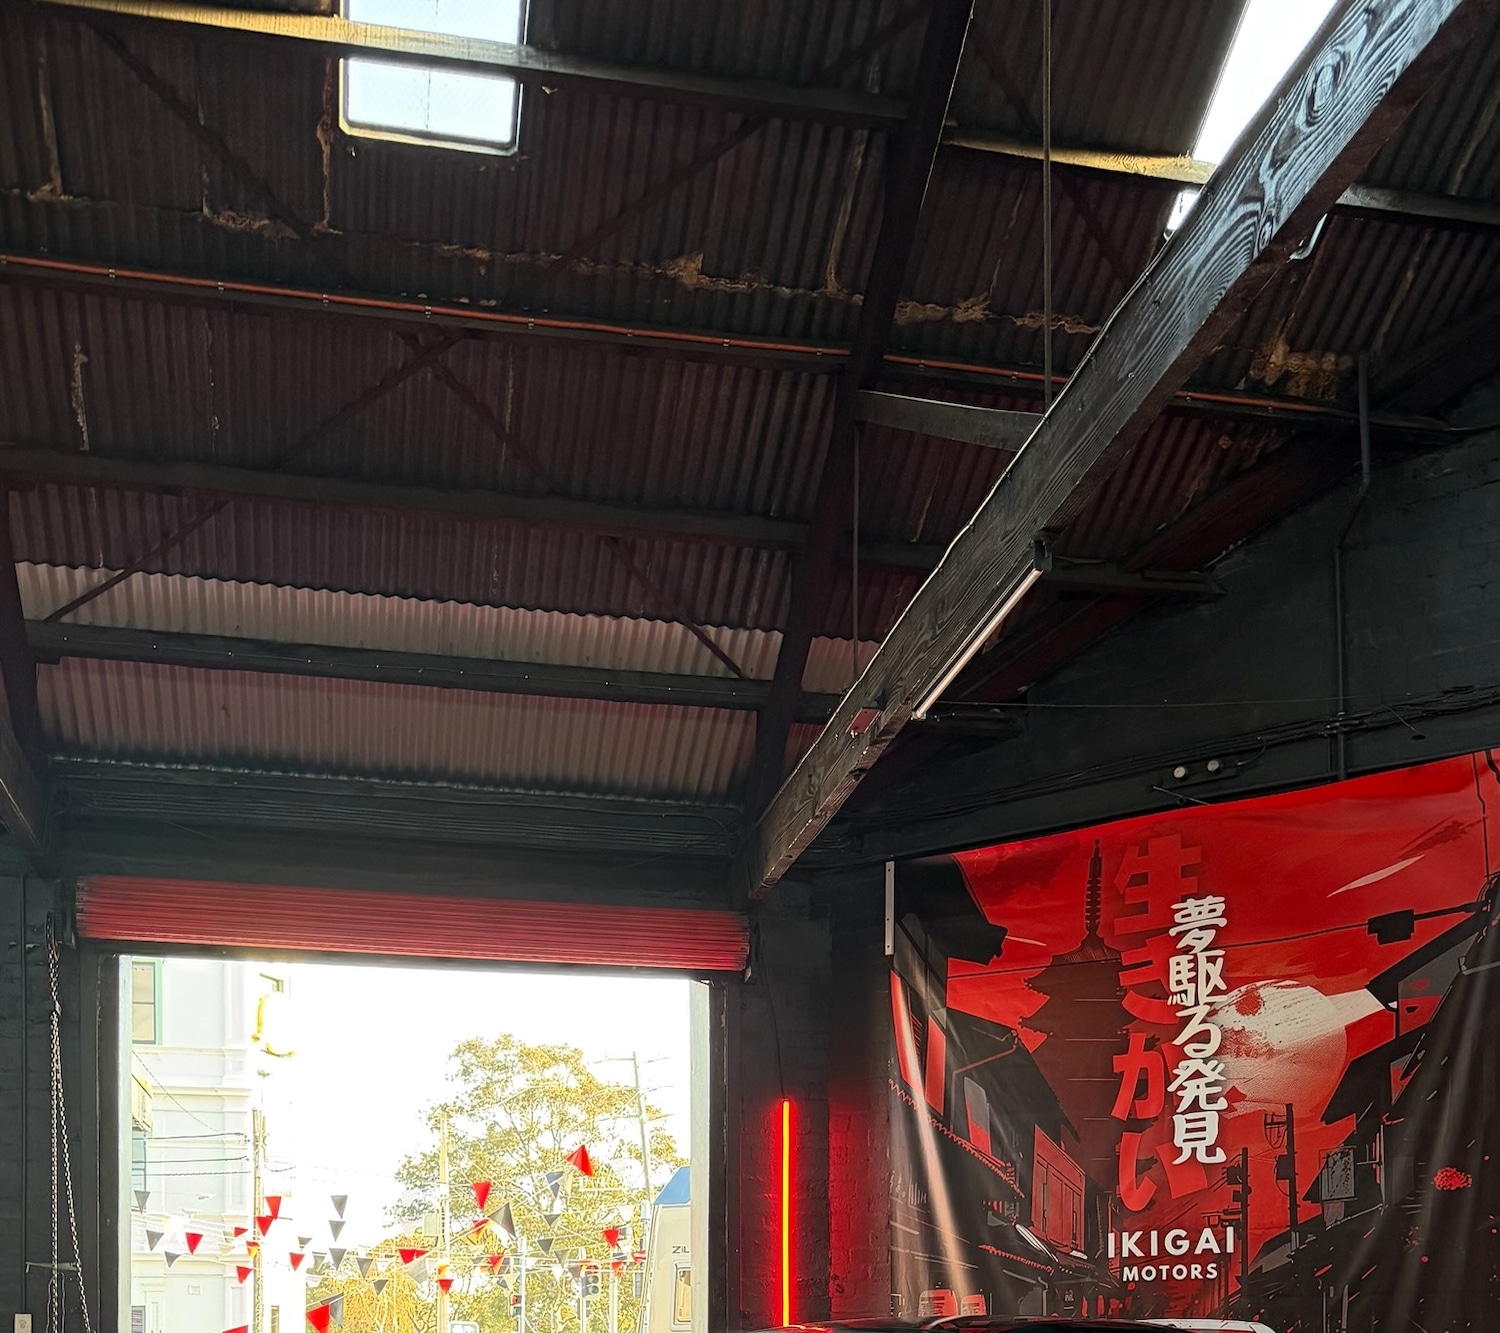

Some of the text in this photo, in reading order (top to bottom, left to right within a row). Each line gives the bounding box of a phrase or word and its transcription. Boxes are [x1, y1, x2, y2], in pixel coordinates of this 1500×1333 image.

[1168, 895, 1228, 1165] 夢駆る発見
[1107, 1225, 1235, 1258] IKIGAI
[1122, 1263, 1218, 1283] MOTORS
